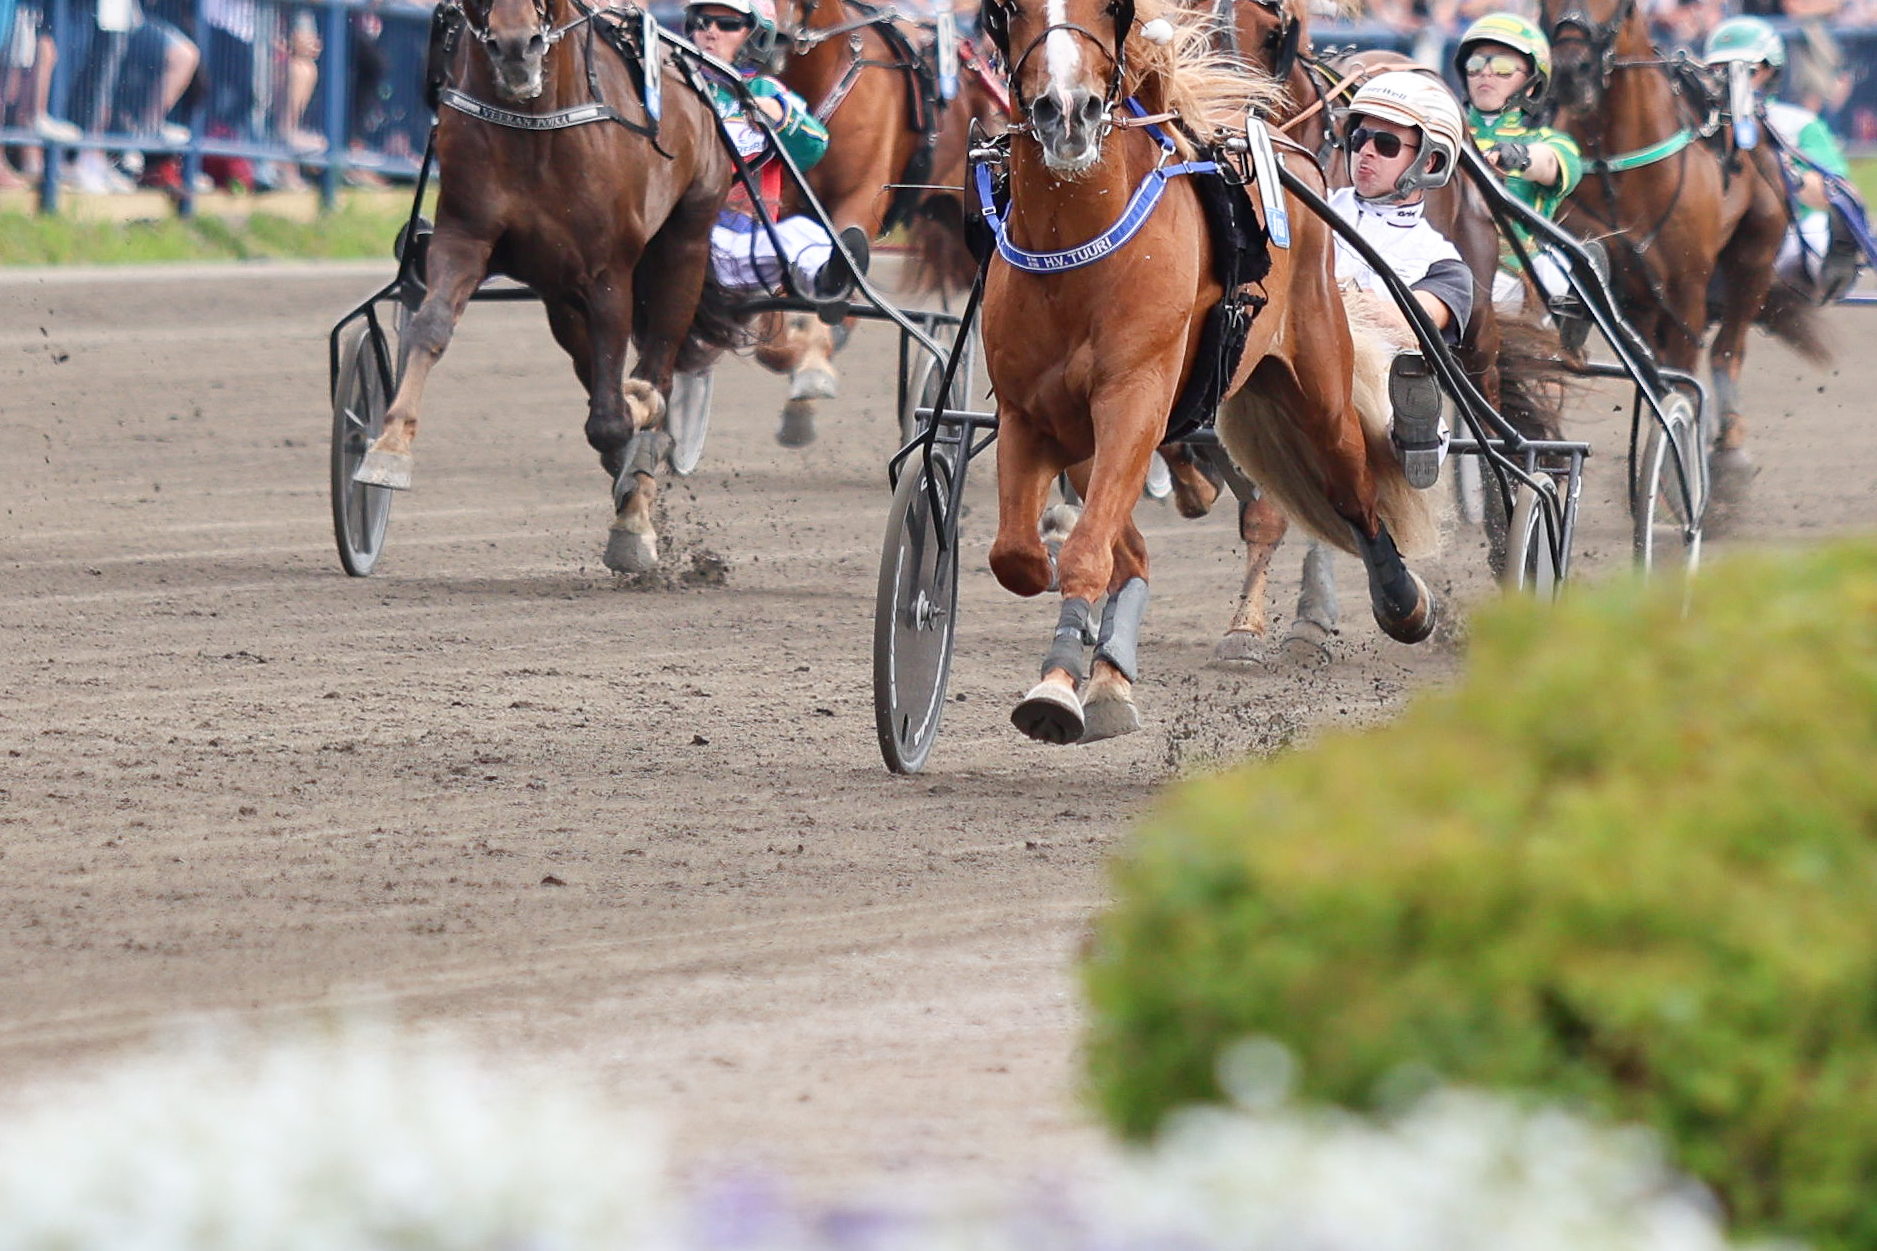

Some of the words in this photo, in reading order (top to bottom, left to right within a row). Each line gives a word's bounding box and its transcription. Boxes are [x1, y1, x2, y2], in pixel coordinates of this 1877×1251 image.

[1255, 124, 1279, 209] 1
[1043, 256, 1069, 268] H.V.
[1067, 236, 1113, 264] TUURI
